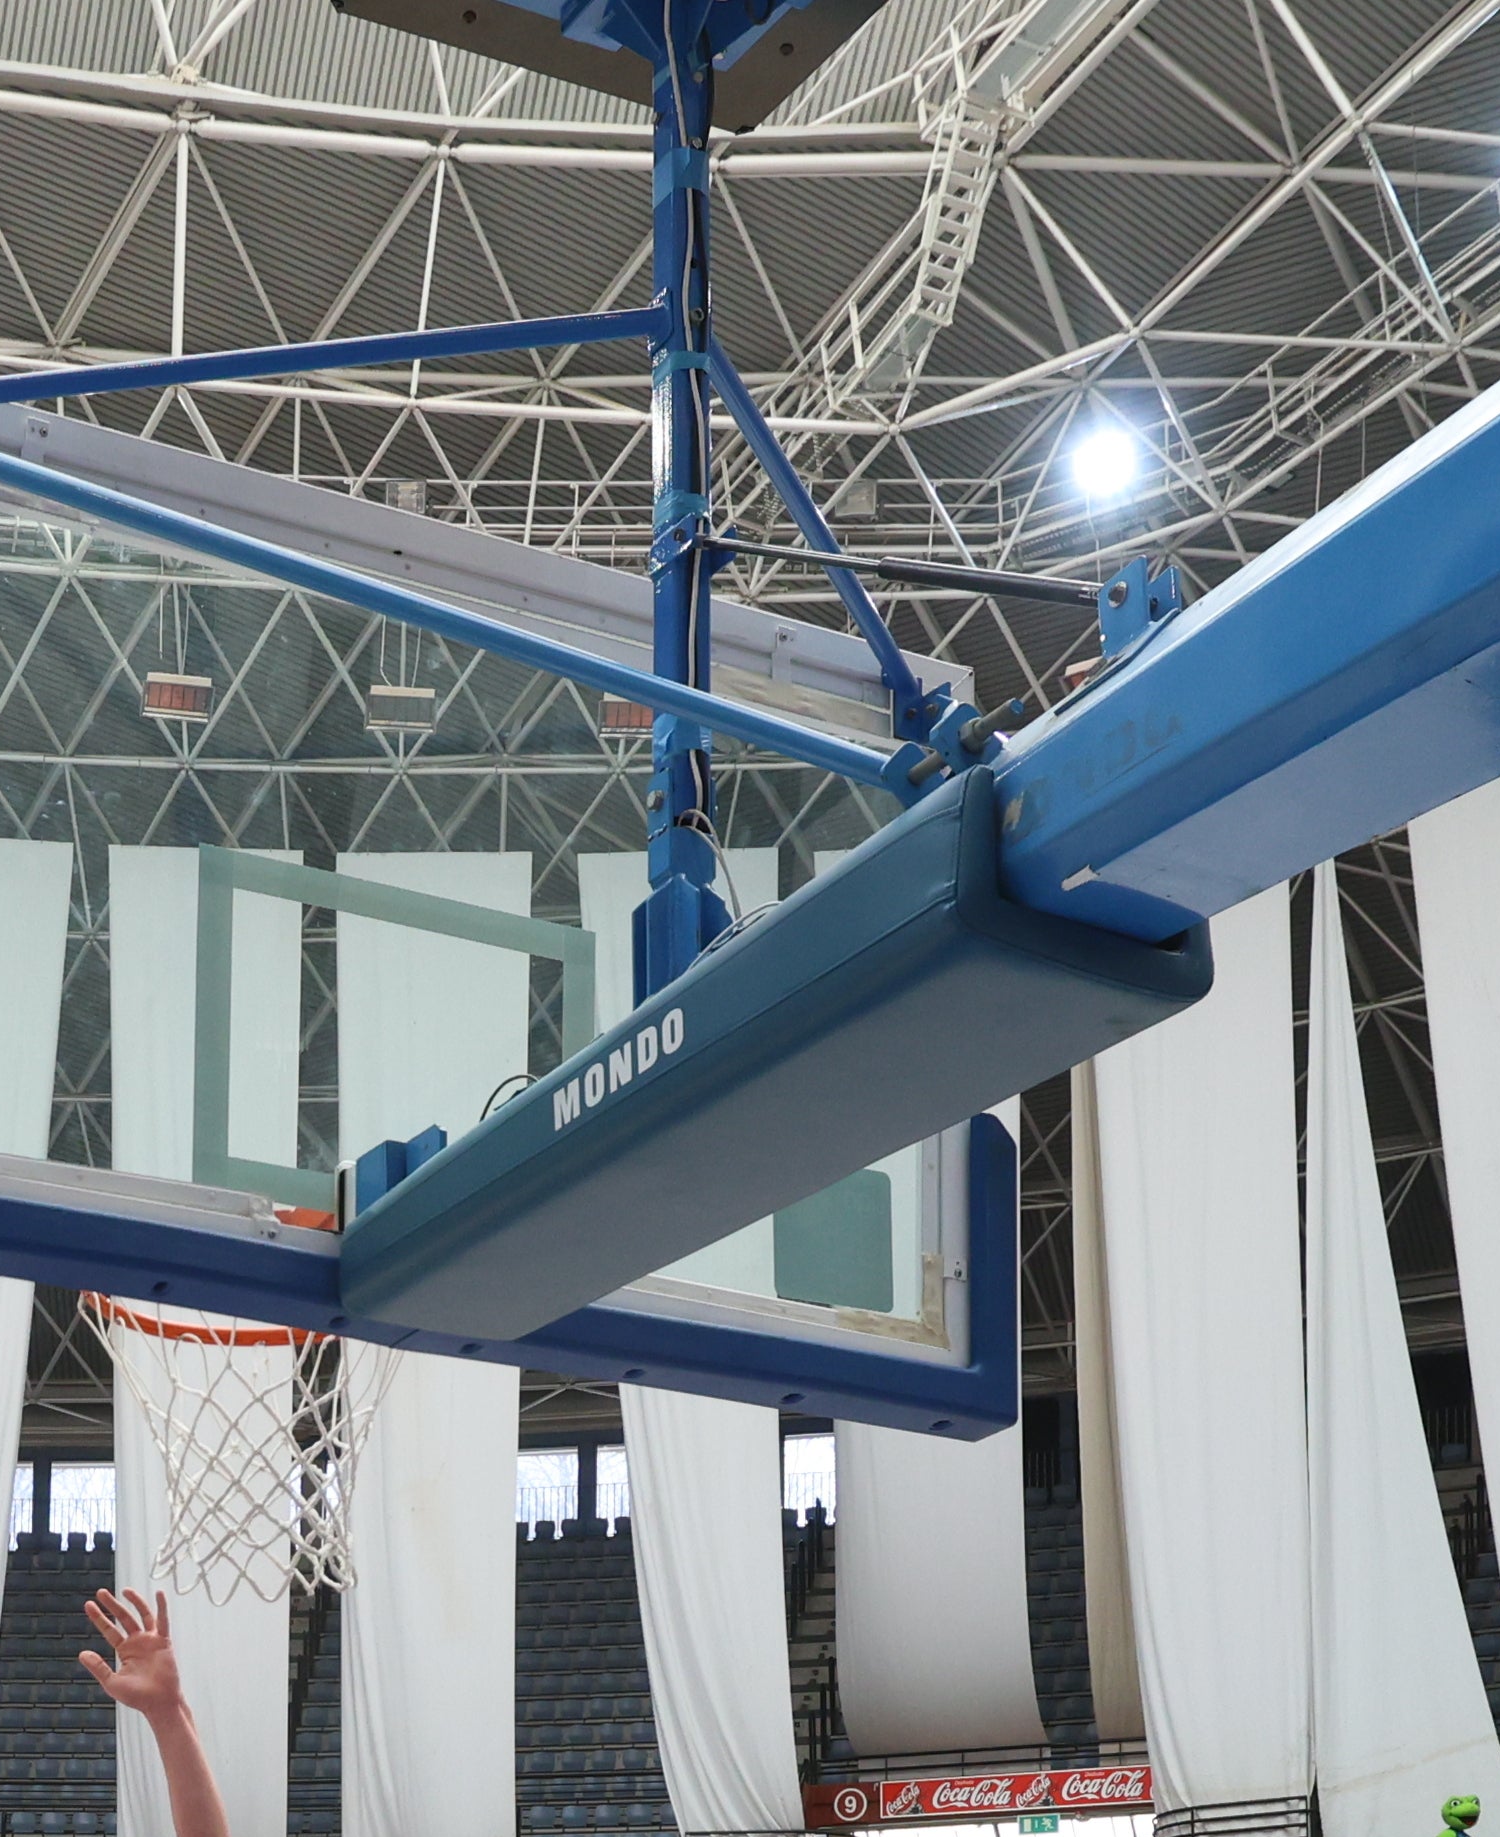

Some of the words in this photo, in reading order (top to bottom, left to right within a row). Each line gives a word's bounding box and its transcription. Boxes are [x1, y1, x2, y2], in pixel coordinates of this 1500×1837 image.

[553, 1006, 686, 1132] MONDO
[932, 1777, 1015, 1809] Coca-Cola
[1061, 1767, 1147, 1801] Coca-Cola
[844, 1796, 857, 1814] 9
